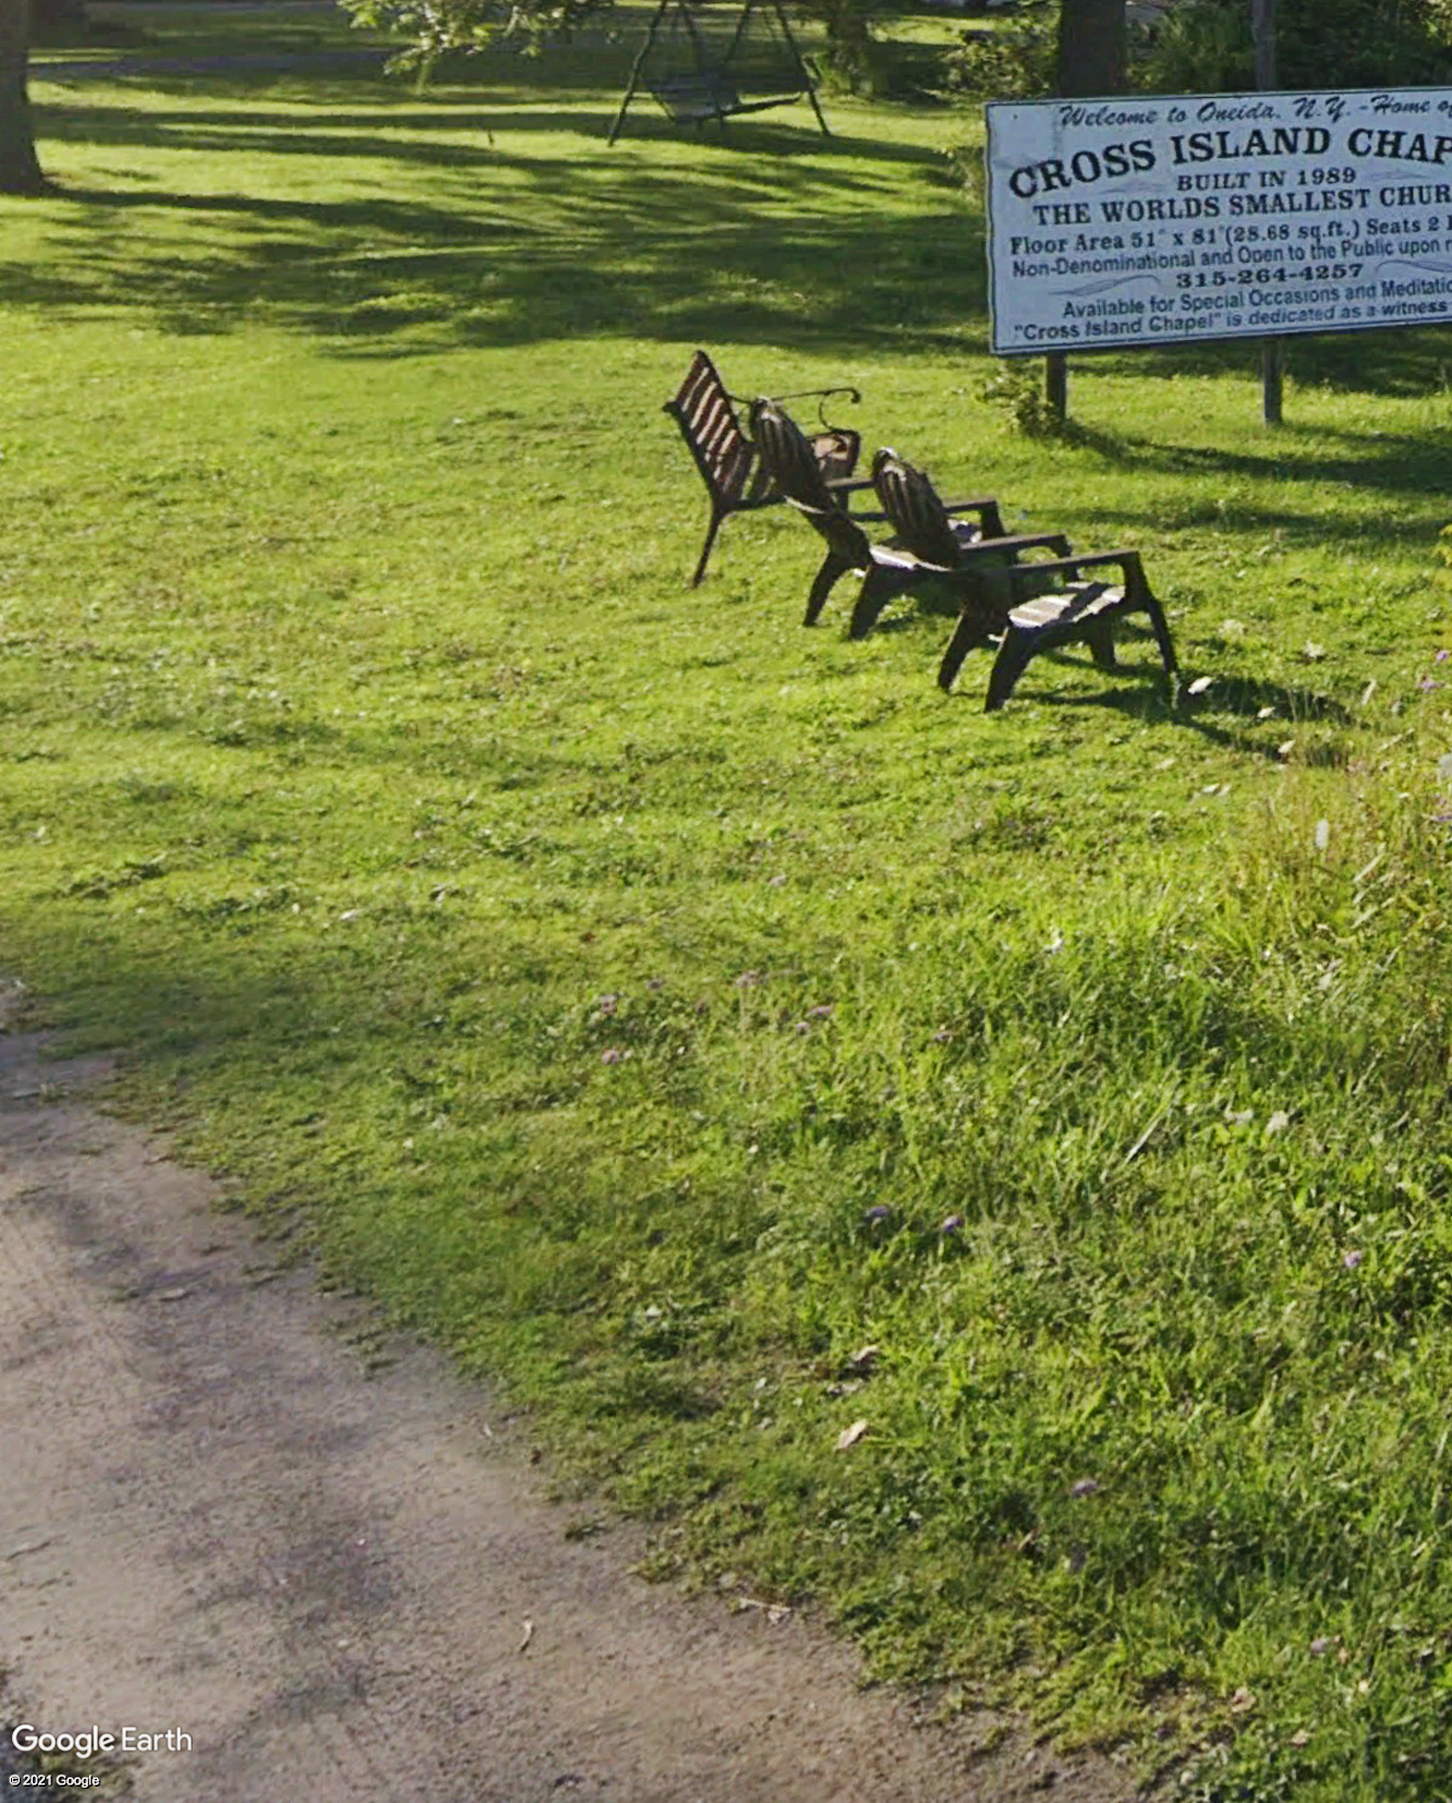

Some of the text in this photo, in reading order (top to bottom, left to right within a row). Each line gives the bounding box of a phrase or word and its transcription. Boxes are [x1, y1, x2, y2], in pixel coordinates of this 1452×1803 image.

[1059, 105, 1157, 126] Welcome
[1167, 107, 1186, 122] to
[1292, 96, 1351, 123] N.Y.
[1009, 139, 1157, 198] CROSS
[1170, 128, 1331, 165] ISLAND
[1176, 167, 1357, 191] BUILT IN 1989
[1032, 202, 1091, 226] THE
[1100, 196, 1220, 223] WORLDS
[1229, 189, 1370, 215] SMALLEST
[1010, 236, 1068, 255] Floor
[1074, 233, 1124, 251] Area
[1172, 232, 1184, 246] x
[1367, 216, 1421, 235] Seats
[1428, 216, 1440, 232] 2
[1013, 250, 1195, 278] Non-Denominational
[1201, 248, 1233, 266] and
[1238, 244, 1285, 265] Open
[1288, 243, 1306, 261] to
[1310, 241, 1336, 260] the
[1342, 238, 1393, 257] Public
[1399, 237, 1440, 257] upon
[1176, 263, 1364, 289] 315-264-4257
[1063, 298, 1145, 318] Available
[1150, 295, 1175, 313] for
[1180, 290, 1244, 311] Special
[1248, 286, 1340, 307] Occasions
[1345, 282, 1376, 300] and
[1085, 318, 1142, 336] Island
[1226, 310, 1242, 326] is
[1248, 304, 1335, 325] dedicated
[1341, 306, 1360, 320] as
[1366, 305, 1376, 317] a
[1381, 297, 1447, 315] witness
